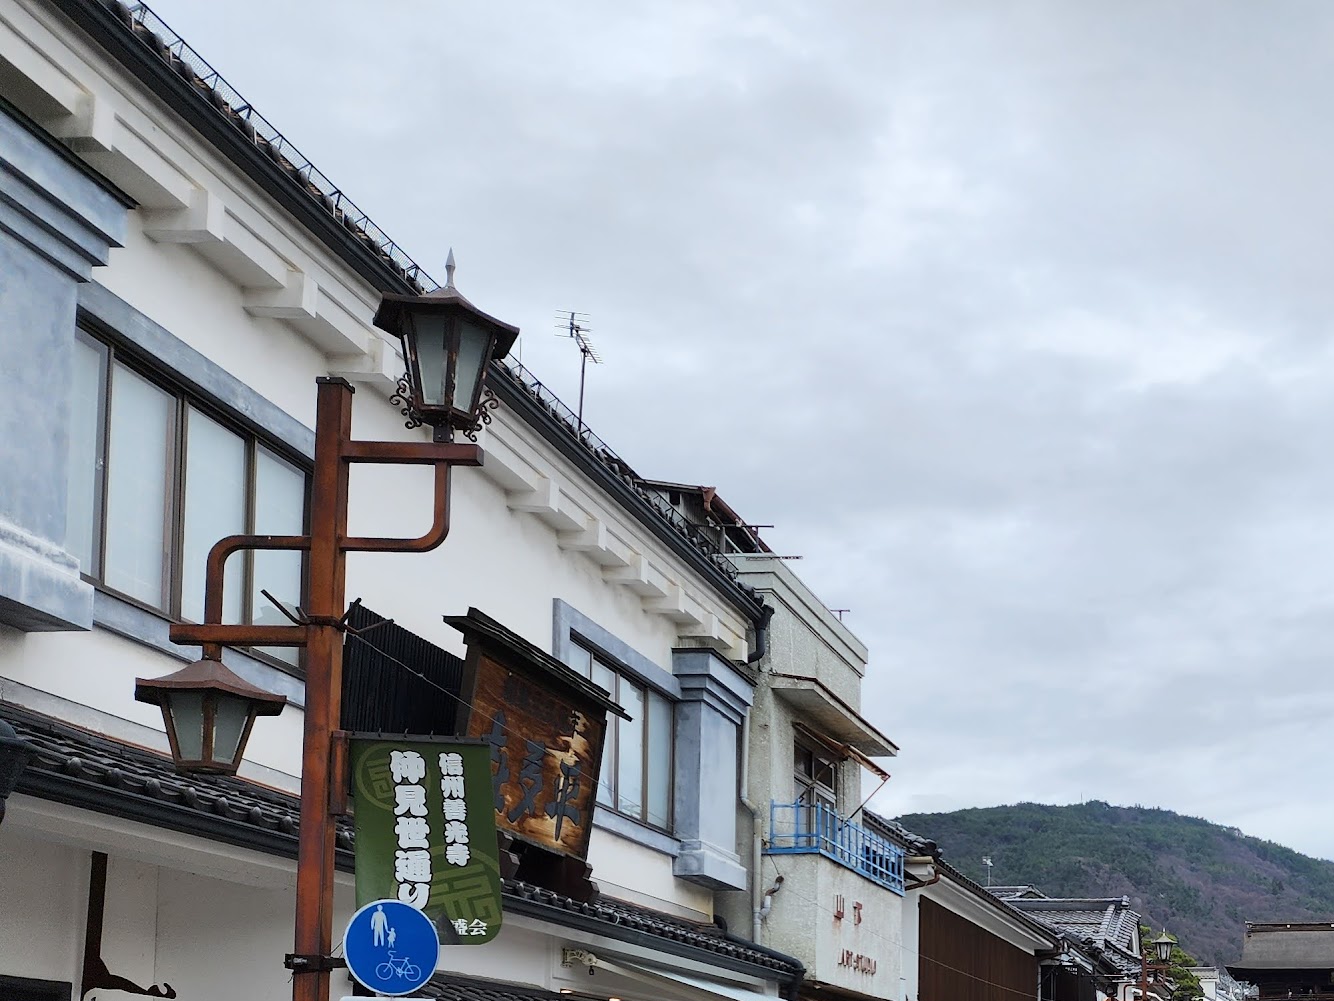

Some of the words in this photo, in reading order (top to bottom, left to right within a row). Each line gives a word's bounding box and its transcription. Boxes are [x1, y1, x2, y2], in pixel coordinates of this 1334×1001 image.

[389, 750, 432, 912] 仲見世通り
[438, 751, 472, 867] 信州善光寺
